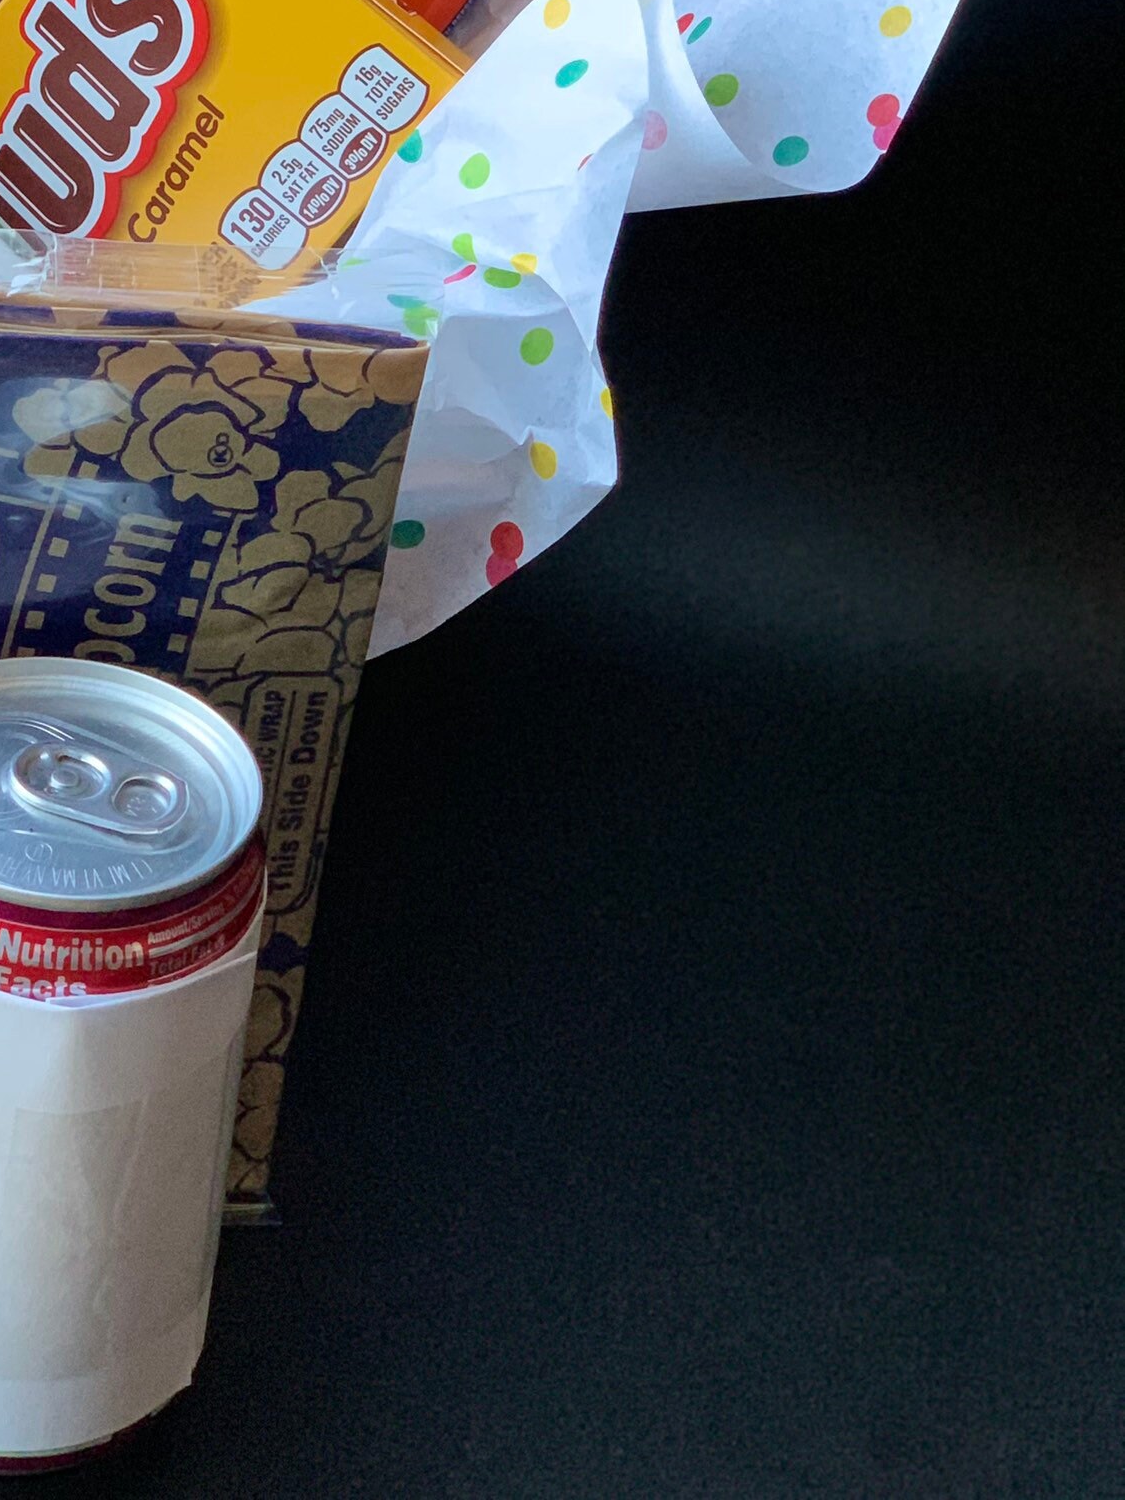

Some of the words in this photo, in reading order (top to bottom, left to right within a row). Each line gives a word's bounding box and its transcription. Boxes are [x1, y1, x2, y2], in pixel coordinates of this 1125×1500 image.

[355, 64, 382, 87] 16g
[365, 71, 398, 104] TOTAL
[376, 77, 416, 121] SUGARS
[309, 107, 345, 139] 75mg
[321, 113, 361, 157] SODIUM
[128, 95, 224, 243] Caramel
[271, 157, 304, 186] 2.5g
[282, 182, 304, 203] SAT
[299, 161, 320, 184] FAT
[231, 196, 275, 243] 130
[250, 214, 290, 258] CALORIES
[258, 689, 287, 744] WRAP
[289, 690, 328, 765] Down
[278, 773, 312, 831] Side
[268, 839, 300, 893] This
[149, 953, 187, 975] Total
